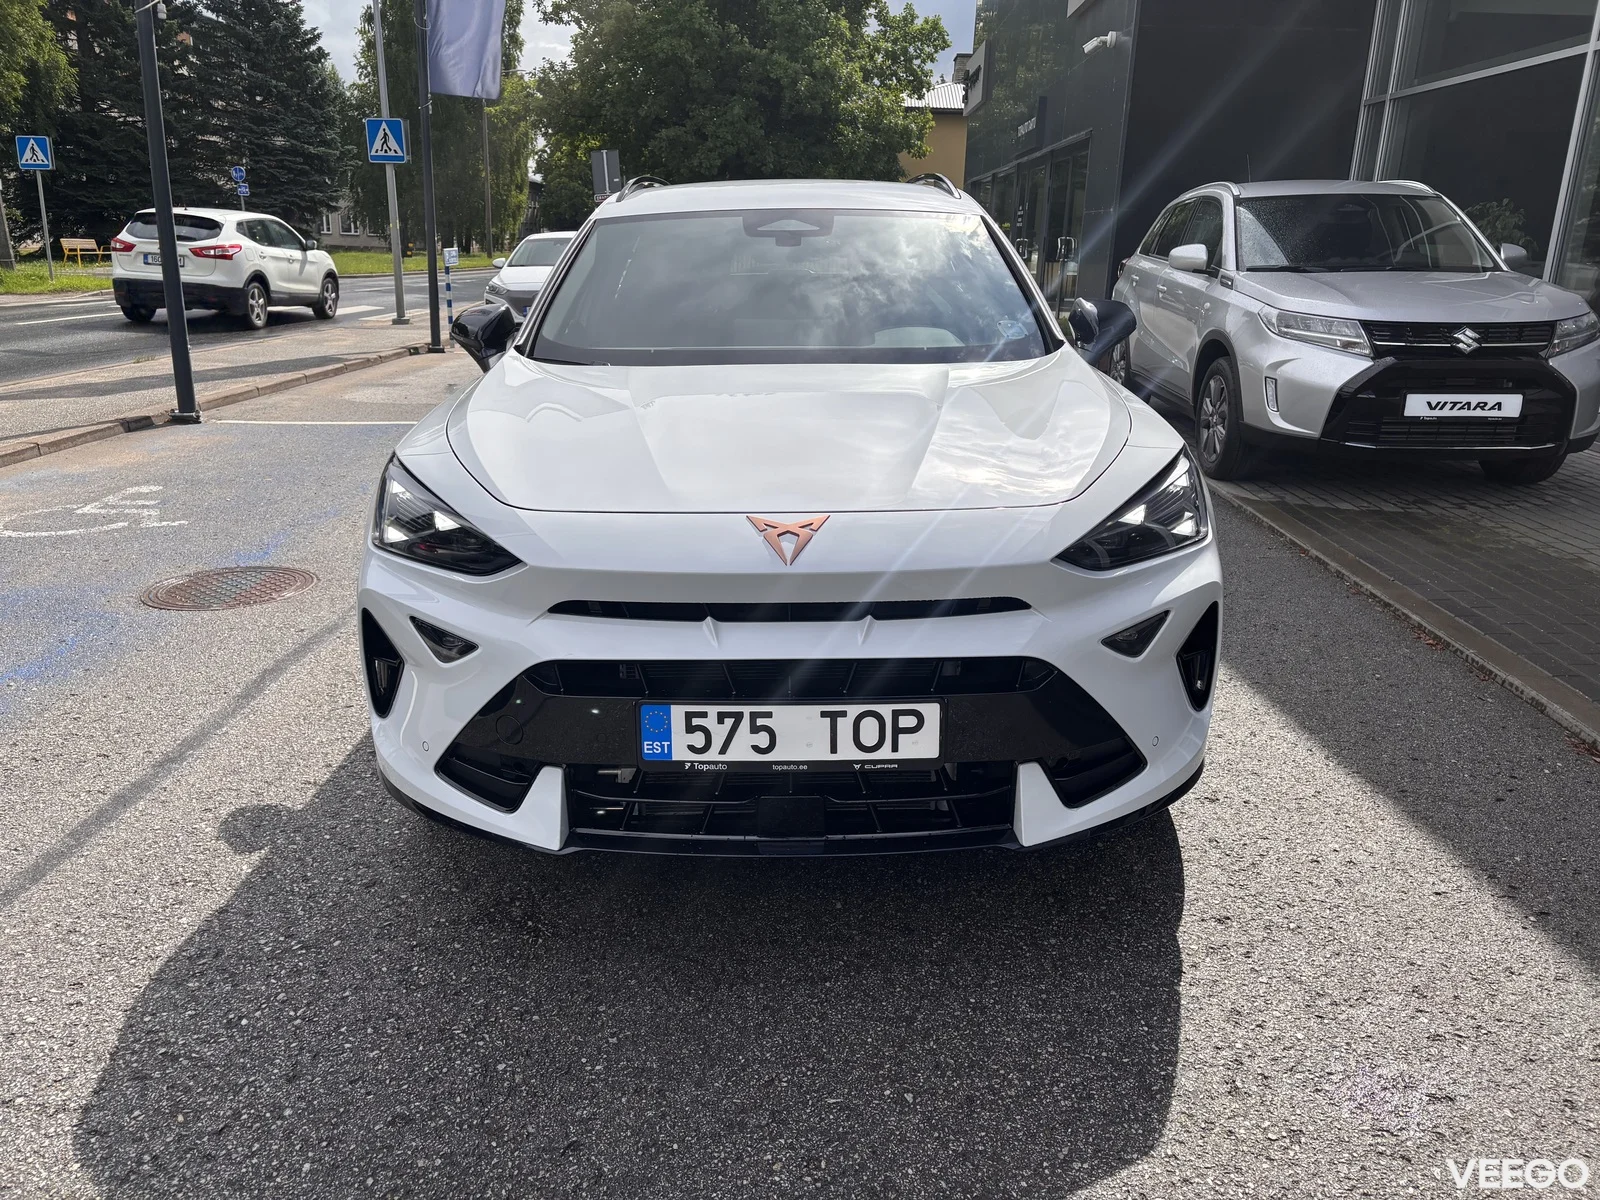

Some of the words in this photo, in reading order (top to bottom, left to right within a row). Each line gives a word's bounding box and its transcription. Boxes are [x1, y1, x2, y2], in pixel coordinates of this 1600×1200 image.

[1426, 401, 1502, 411] VITARA
[684, 710, 777, 755] 575
[820, 709, 925, 754] TOP
[644, 741, 670, 754] EST
[693, 762, 728, 771] Topauto
